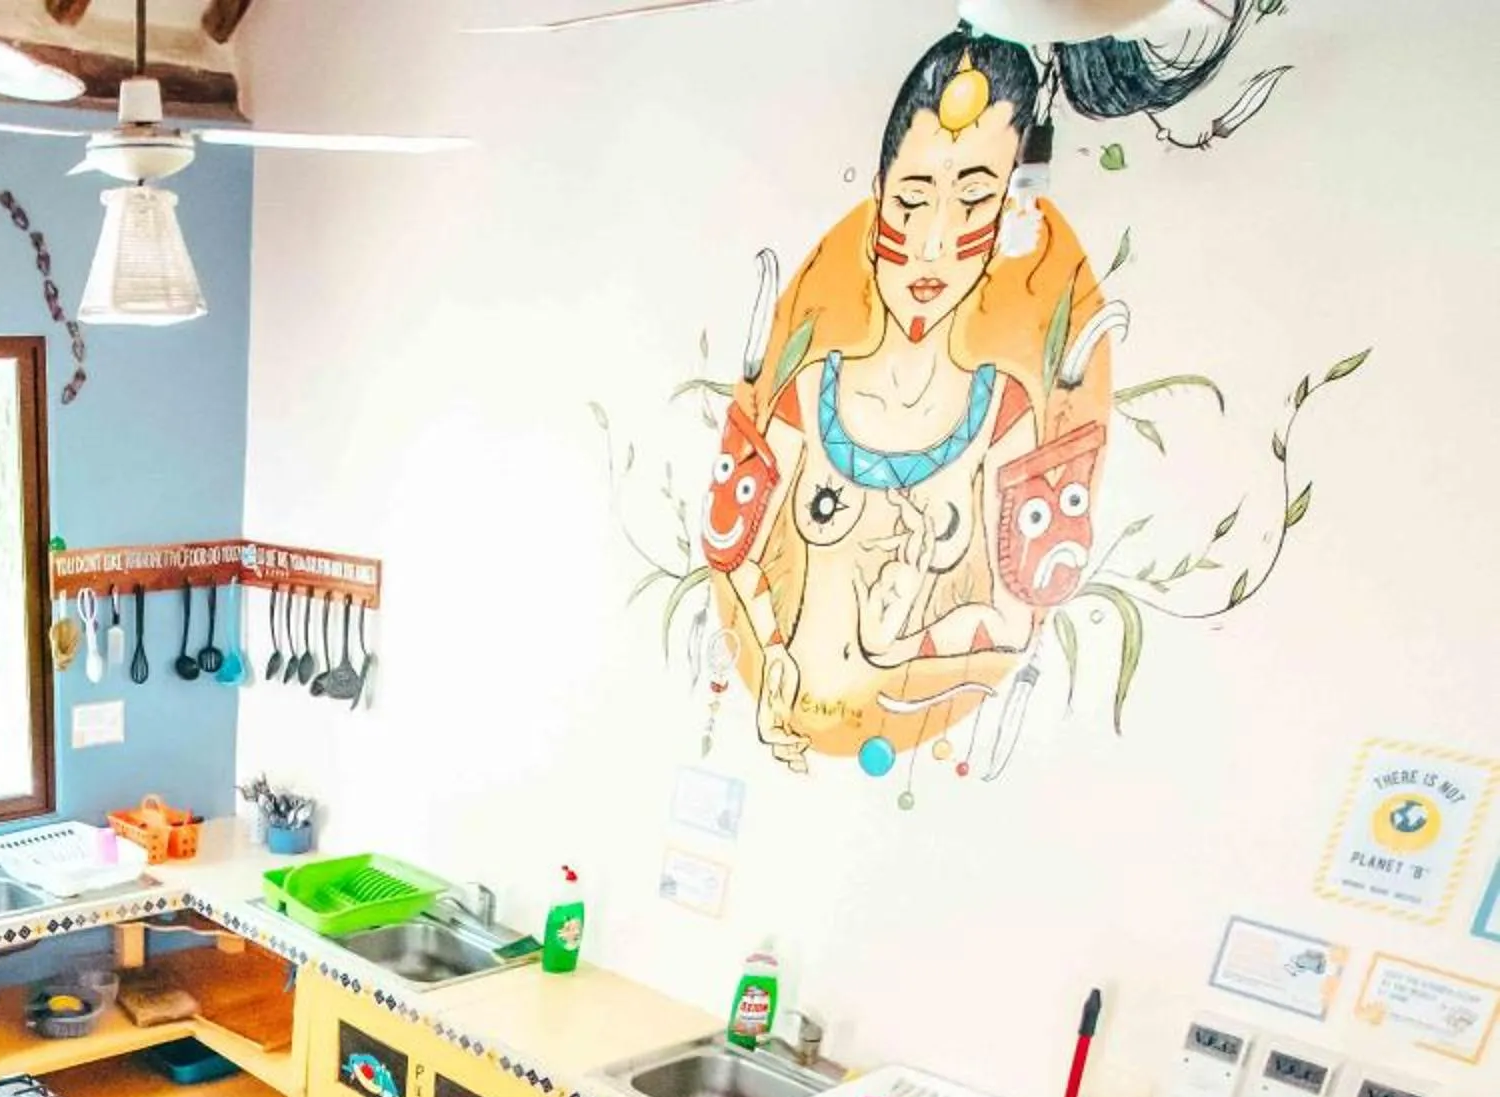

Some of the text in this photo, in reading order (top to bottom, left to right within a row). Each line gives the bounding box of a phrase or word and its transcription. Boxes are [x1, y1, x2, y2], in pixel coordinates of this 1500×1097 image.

[1373, 769, 1466, 805] THERE IS NOT
[1349, 850, 1404, 875] PLANET
